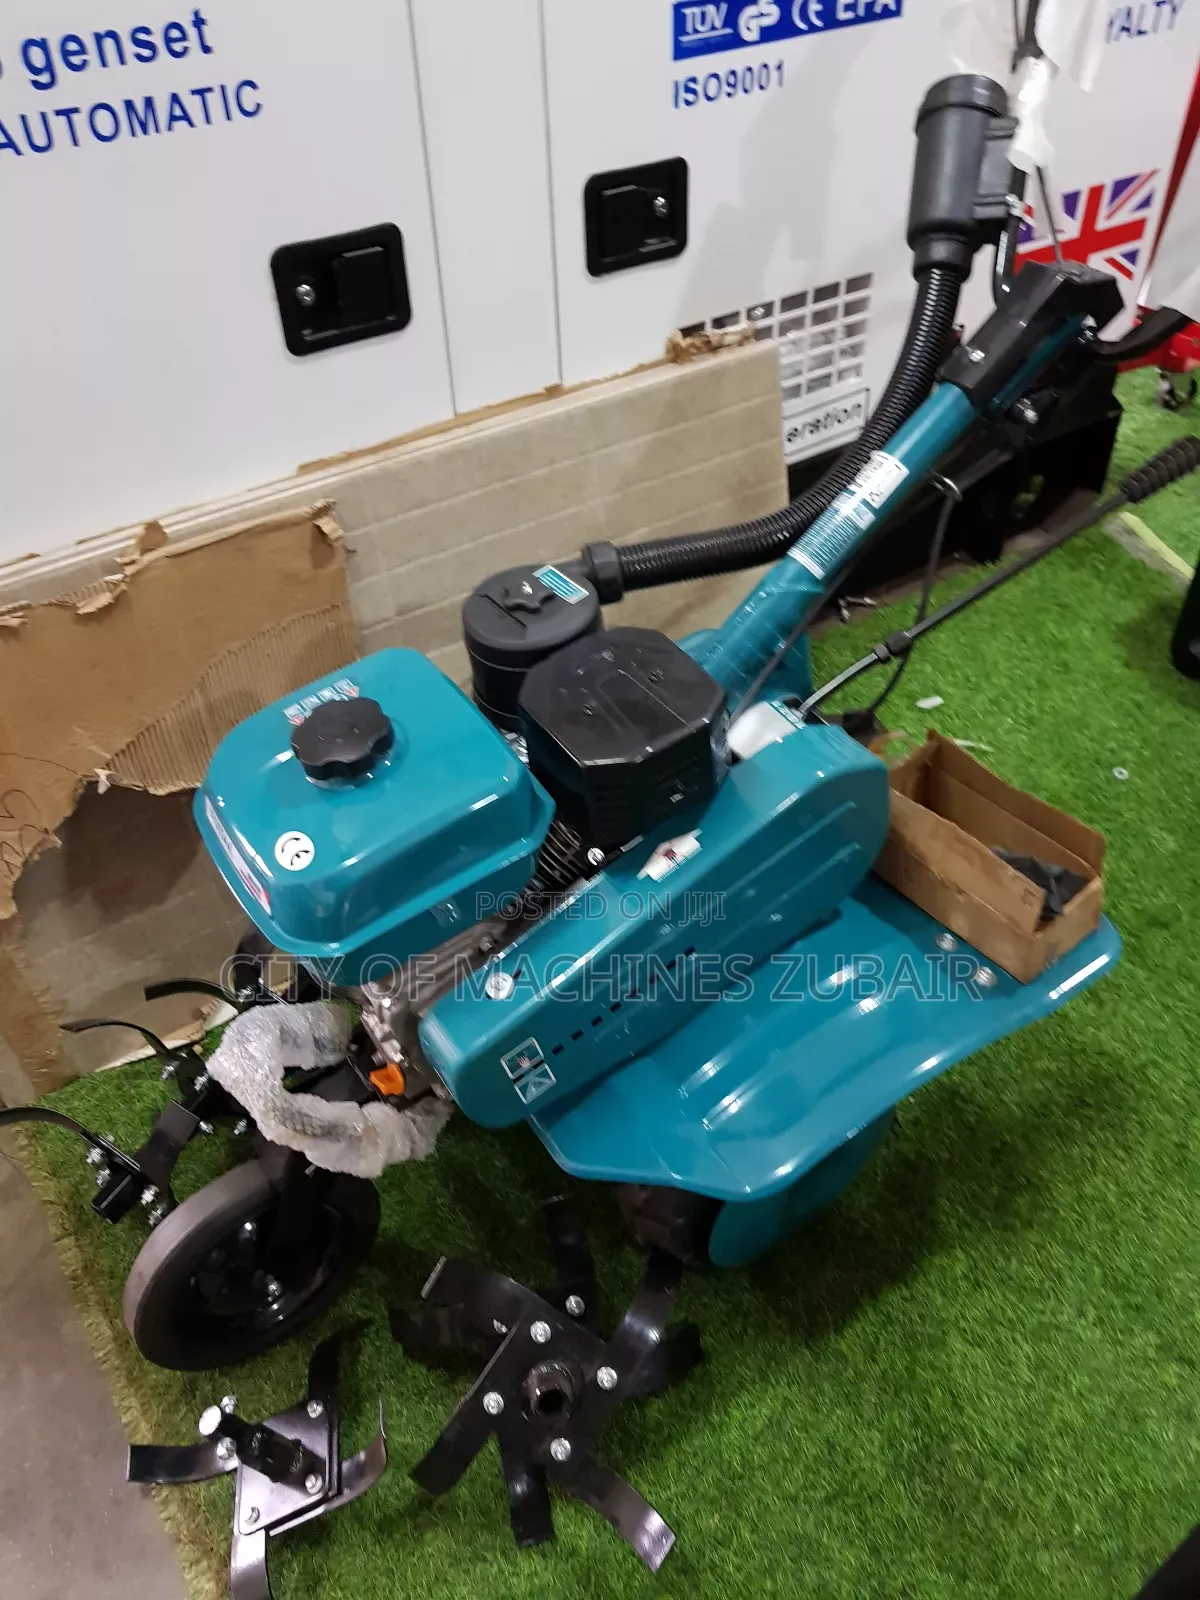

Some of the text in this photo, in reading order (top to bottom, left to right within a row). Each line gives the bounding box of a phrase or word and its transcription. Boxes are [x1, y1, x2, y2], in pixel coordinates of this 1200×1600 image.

[20, 8, 214, 91] genset
[672, 59, 785, 110] ISO9001
[0, 79, 262, 156] AUTOMATIC
